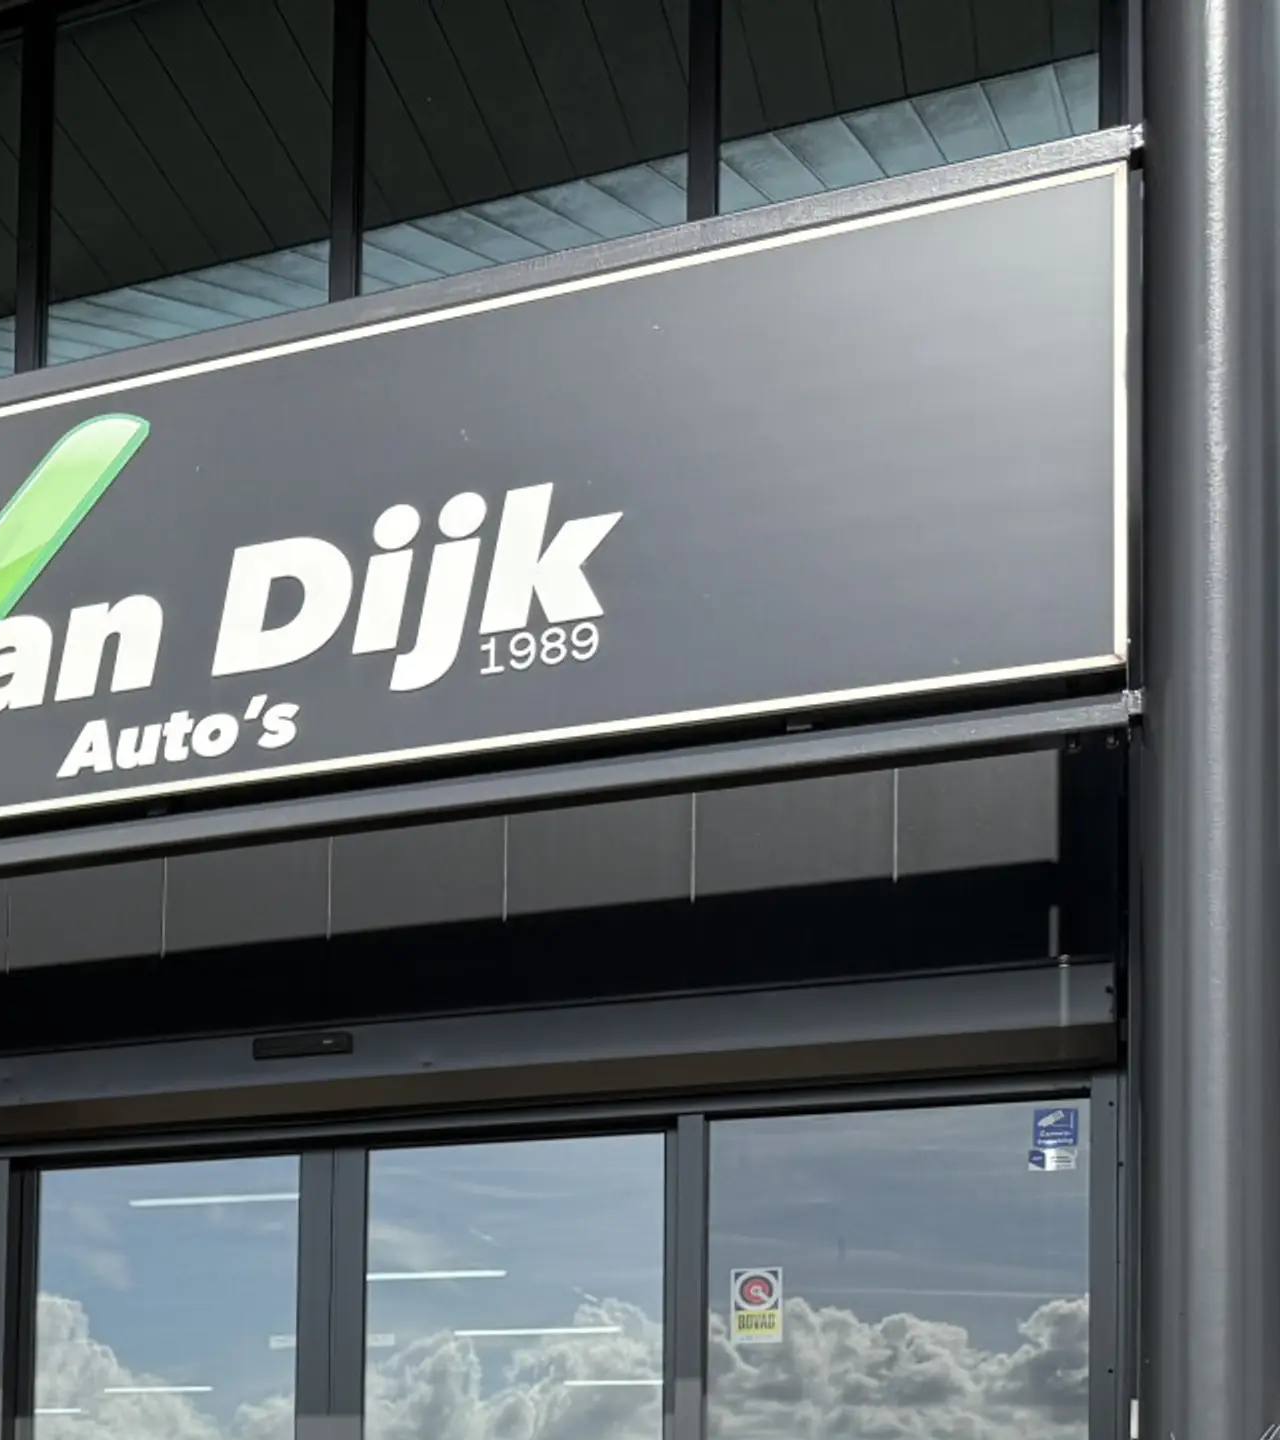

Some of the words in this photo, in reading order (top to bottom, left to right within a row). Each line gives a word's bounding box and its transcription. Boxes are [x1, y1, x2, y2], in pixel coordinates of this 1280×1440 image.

[211, 481, 624, 692] Dijk
[480, 621, 600, 675] 1989
[56, 693, 297, 778] Auto's
